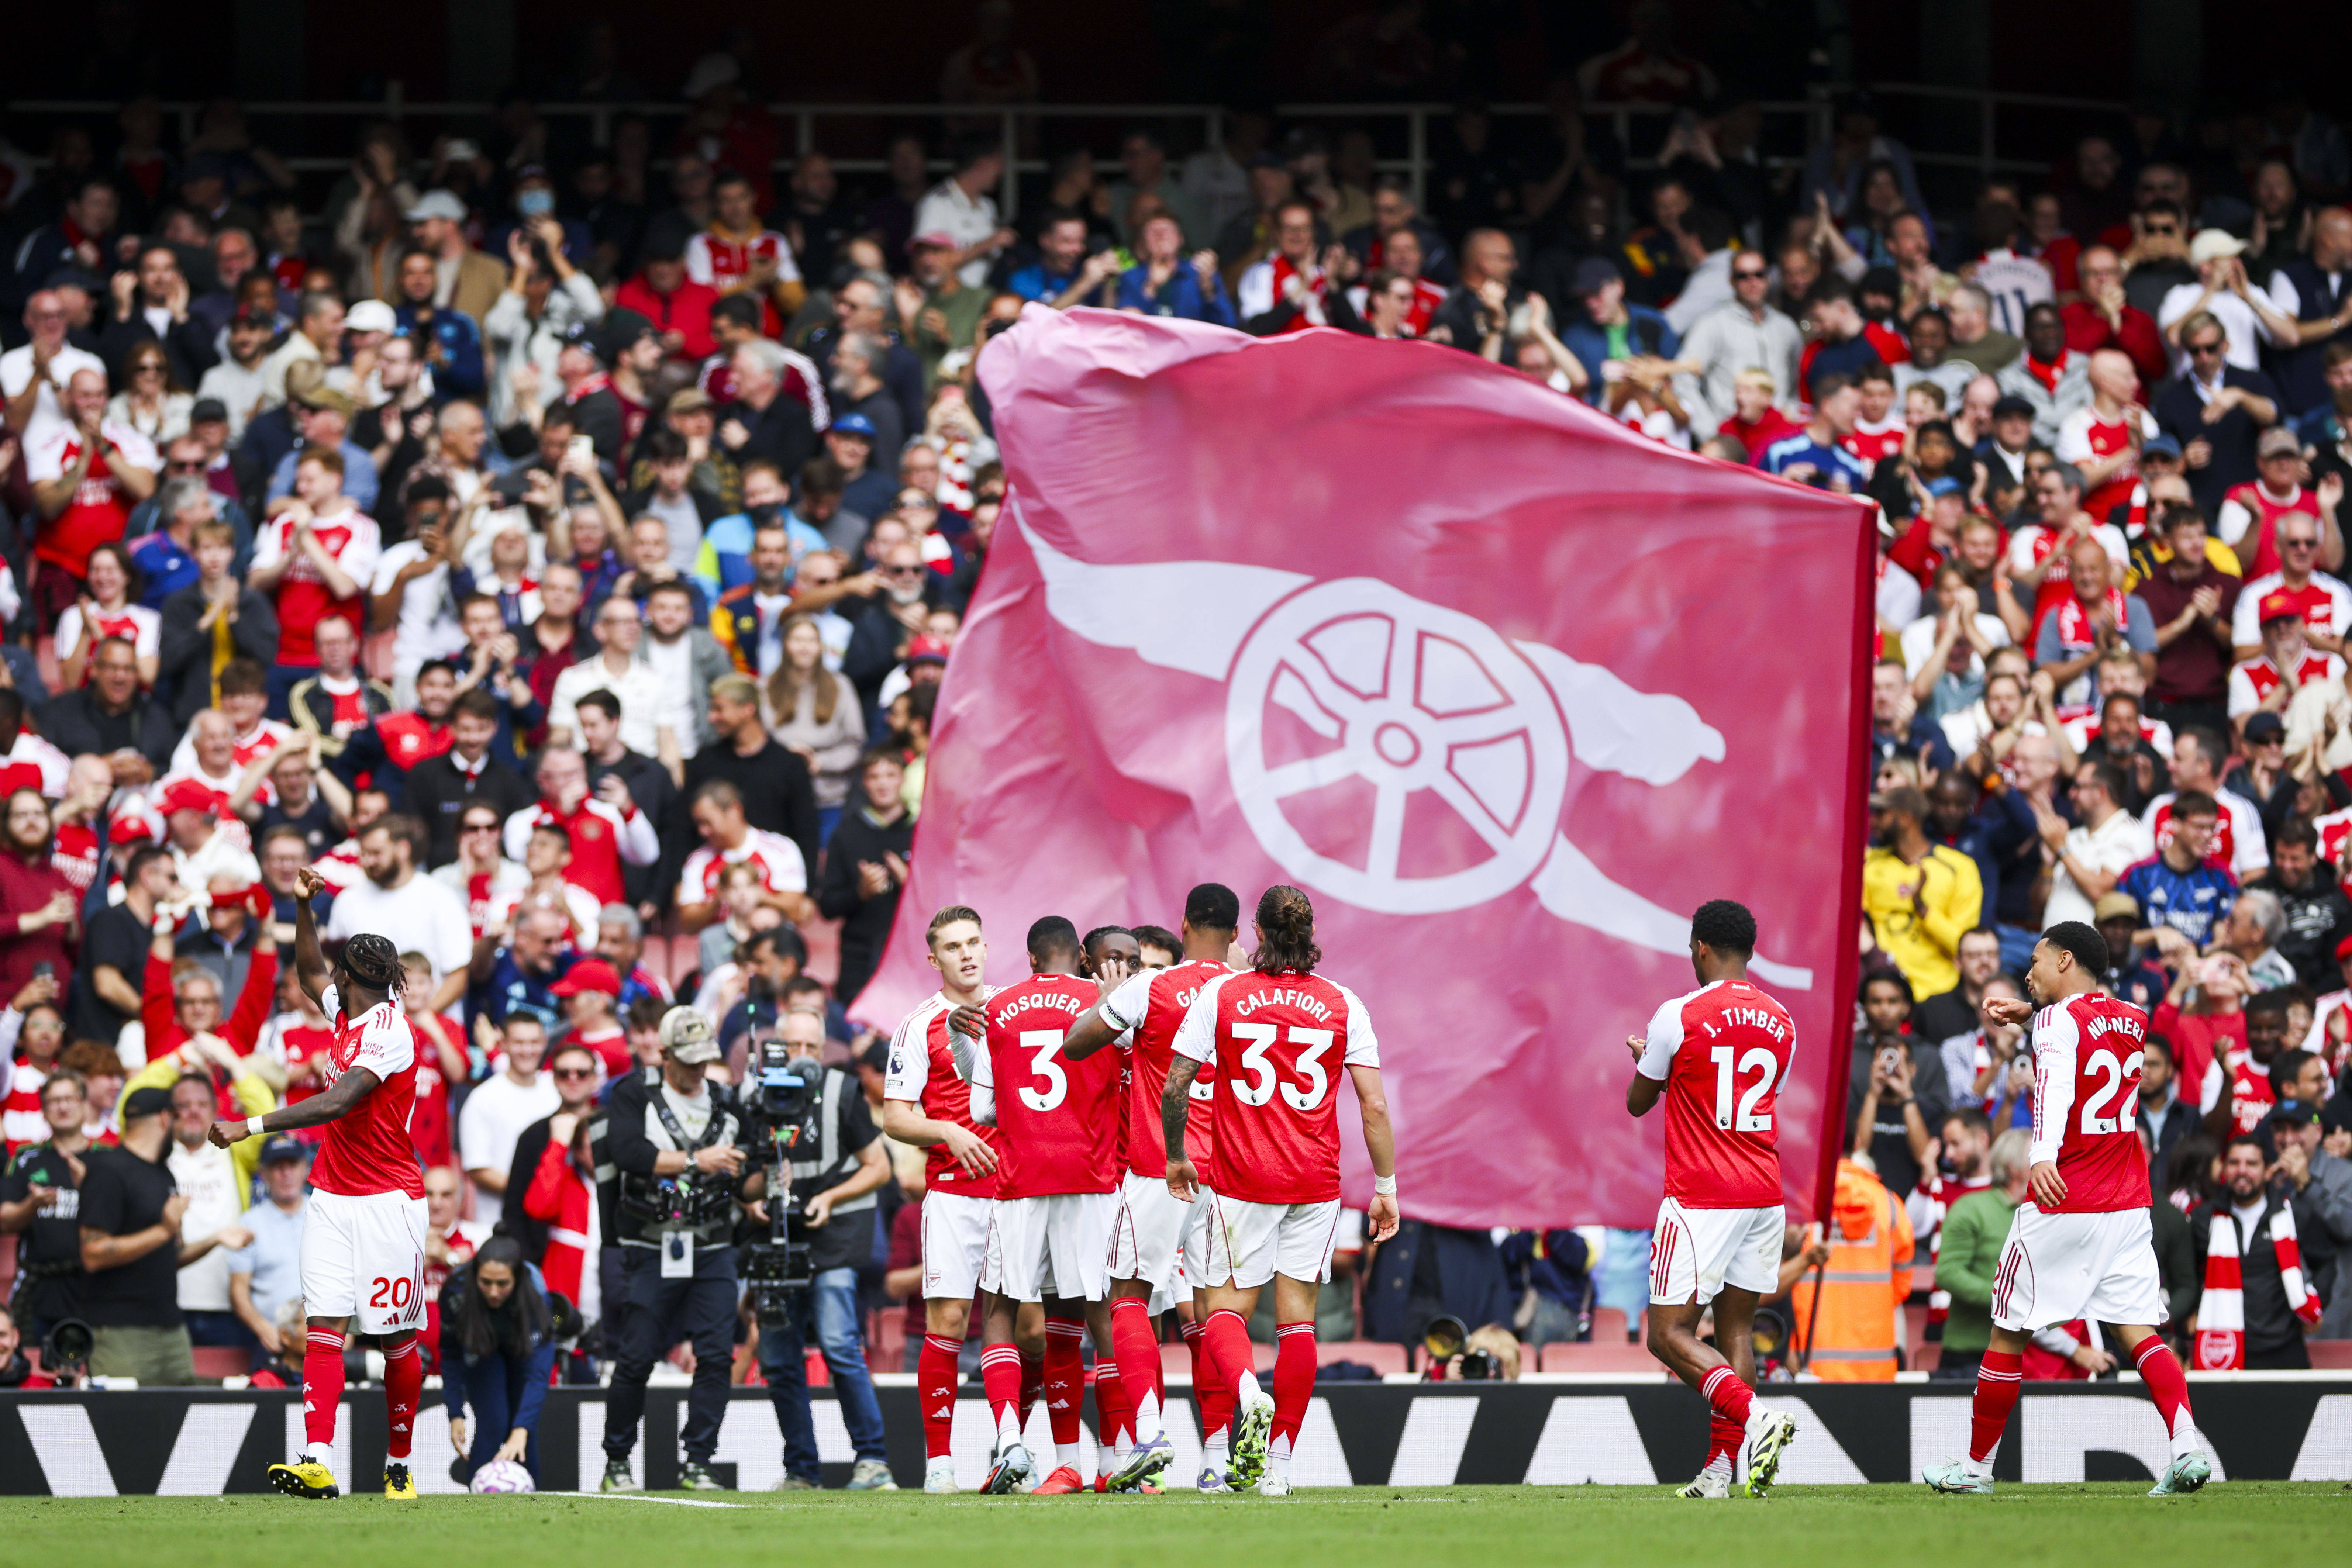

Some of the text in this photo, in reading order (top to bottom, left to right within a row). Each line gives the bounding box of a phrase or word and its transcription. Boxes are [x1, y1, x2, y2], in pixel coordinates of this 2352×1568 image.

[1236, 988, 1332, 1023] CALAFIORI
[1703, 1007, 1785, 1043] J. TIMBER
[365, 1042, 383, 1051] VISIT
[1018, 1029, 1068, 1112] 3
[1230, 1022, 1334, 1111] 33
[1710, 1046, 1778, 1132] 12
[2081, 1049, 2145, 1135] 22
[370, 1277, 411, 1308] 20
